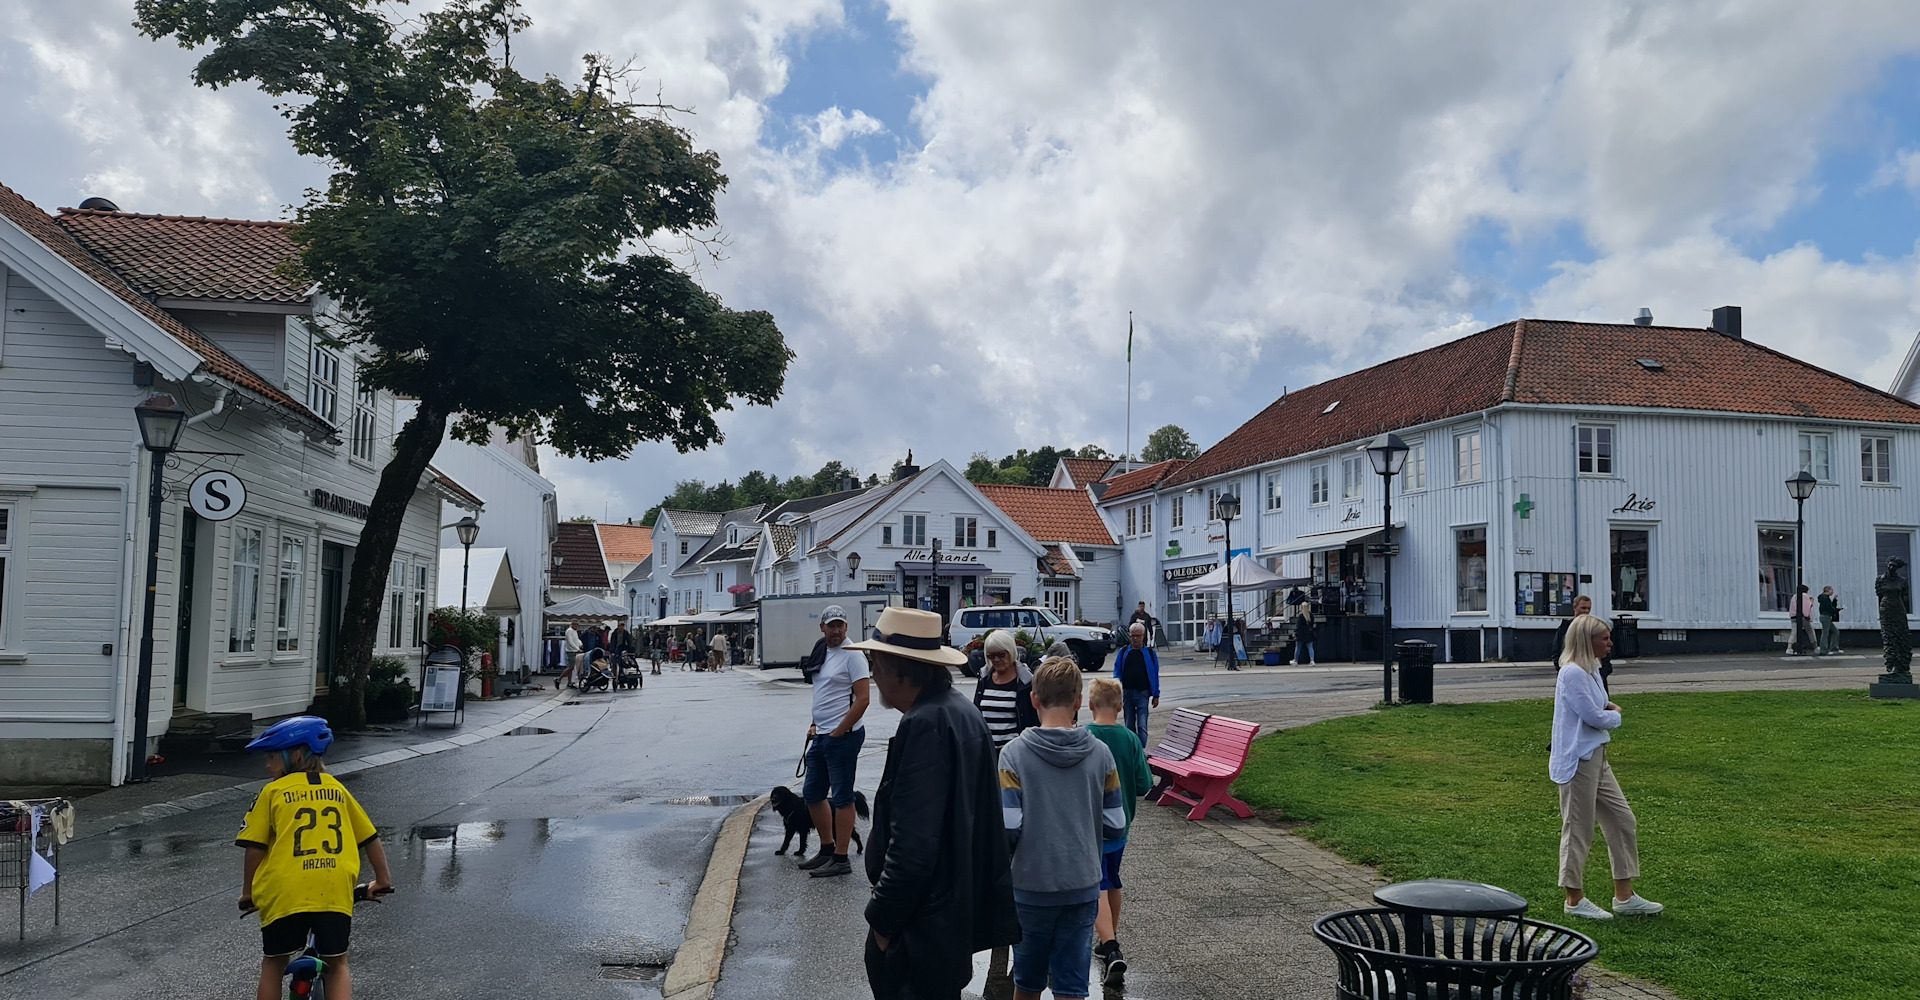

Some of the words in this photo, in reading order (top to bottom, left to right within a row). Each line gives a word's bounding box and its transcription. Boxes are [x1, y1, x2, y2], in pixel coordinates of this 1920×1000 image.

[205, 479, 231, 512] S
[1612, 493, 1656, 513] Iris
[1341, 507, 1361, 524] Iris
[1173, 568, 1187, 577] OLE
[1186, 564, 1208, 575] OLSEN
[293, 806, 343, 857] 23
[303, 858, 336, 870] HAZARD
